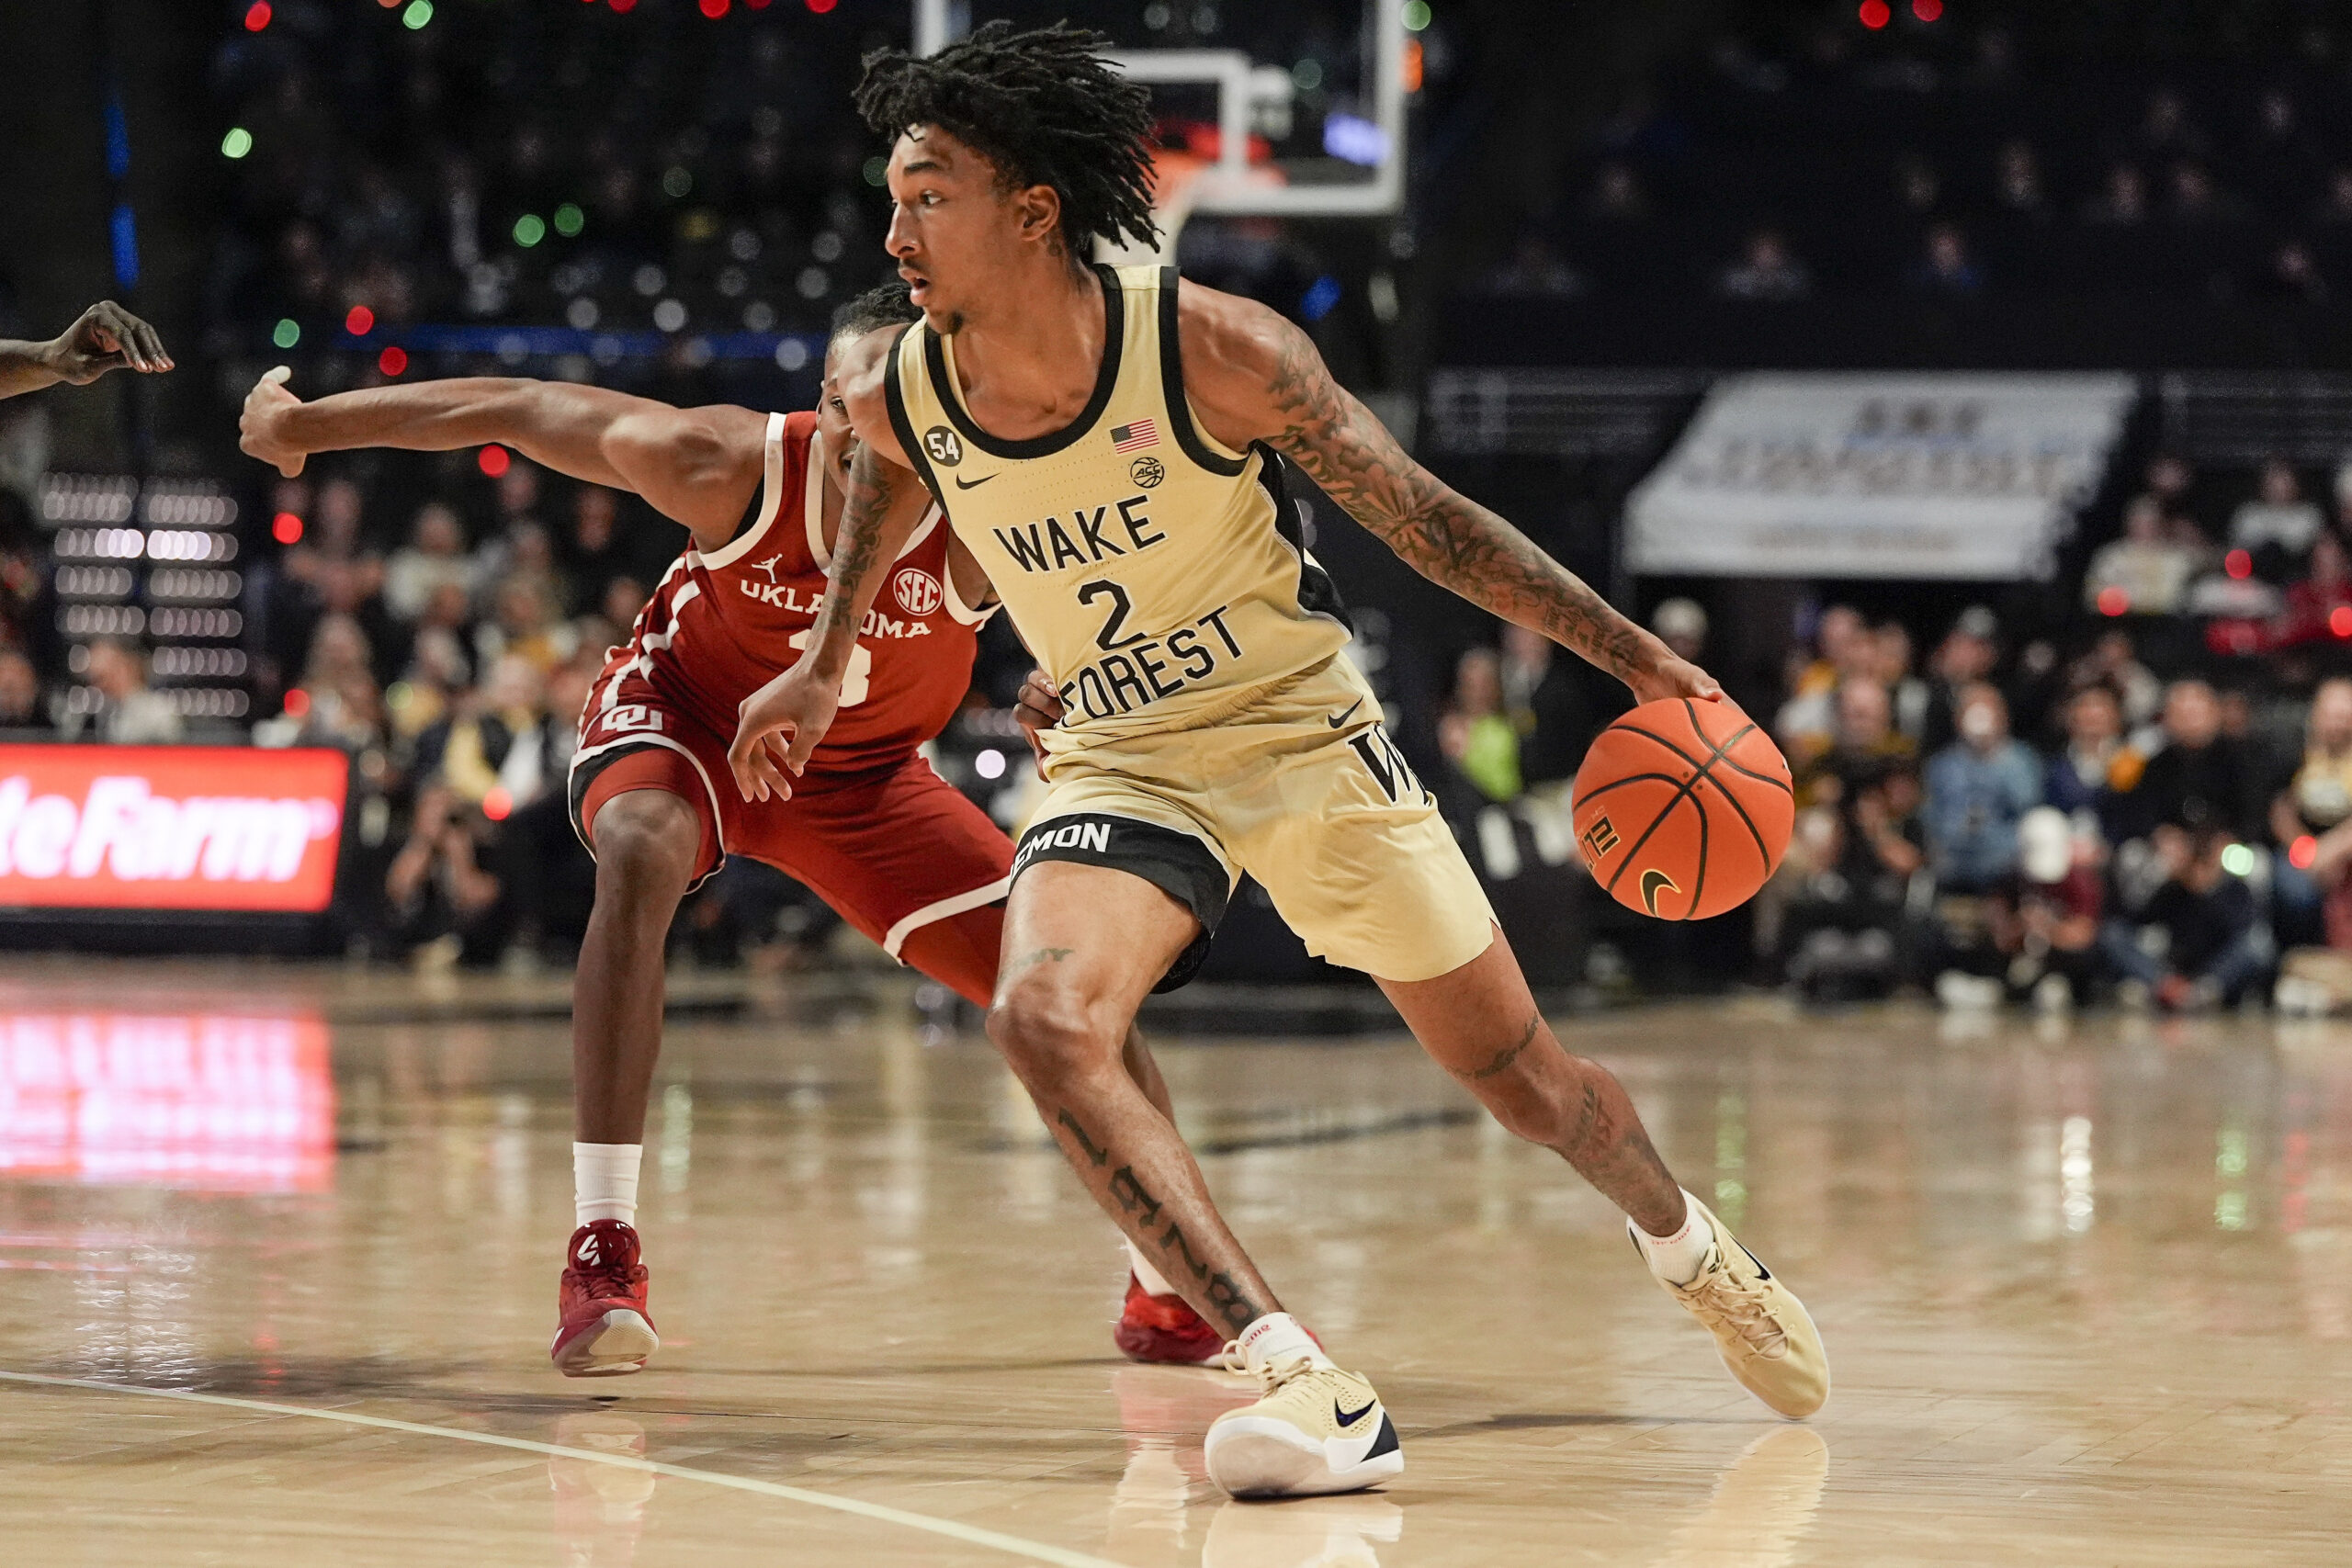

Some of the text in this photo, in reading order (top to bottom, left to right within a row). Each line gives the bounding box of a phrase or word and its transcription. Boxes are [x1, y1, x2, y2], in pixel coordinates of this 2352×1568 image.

[926, 433, 960, 460] 54
[992, 494, 1167, 572] WAKE
[741, 579, 932, 638] OKLAOMA
[897, 571, 940, 613] SEC
[1077, 579, 1148, 652] 2
[601, 704, 663, 732] OU
[1011, 822, 1112, 882] EMON
